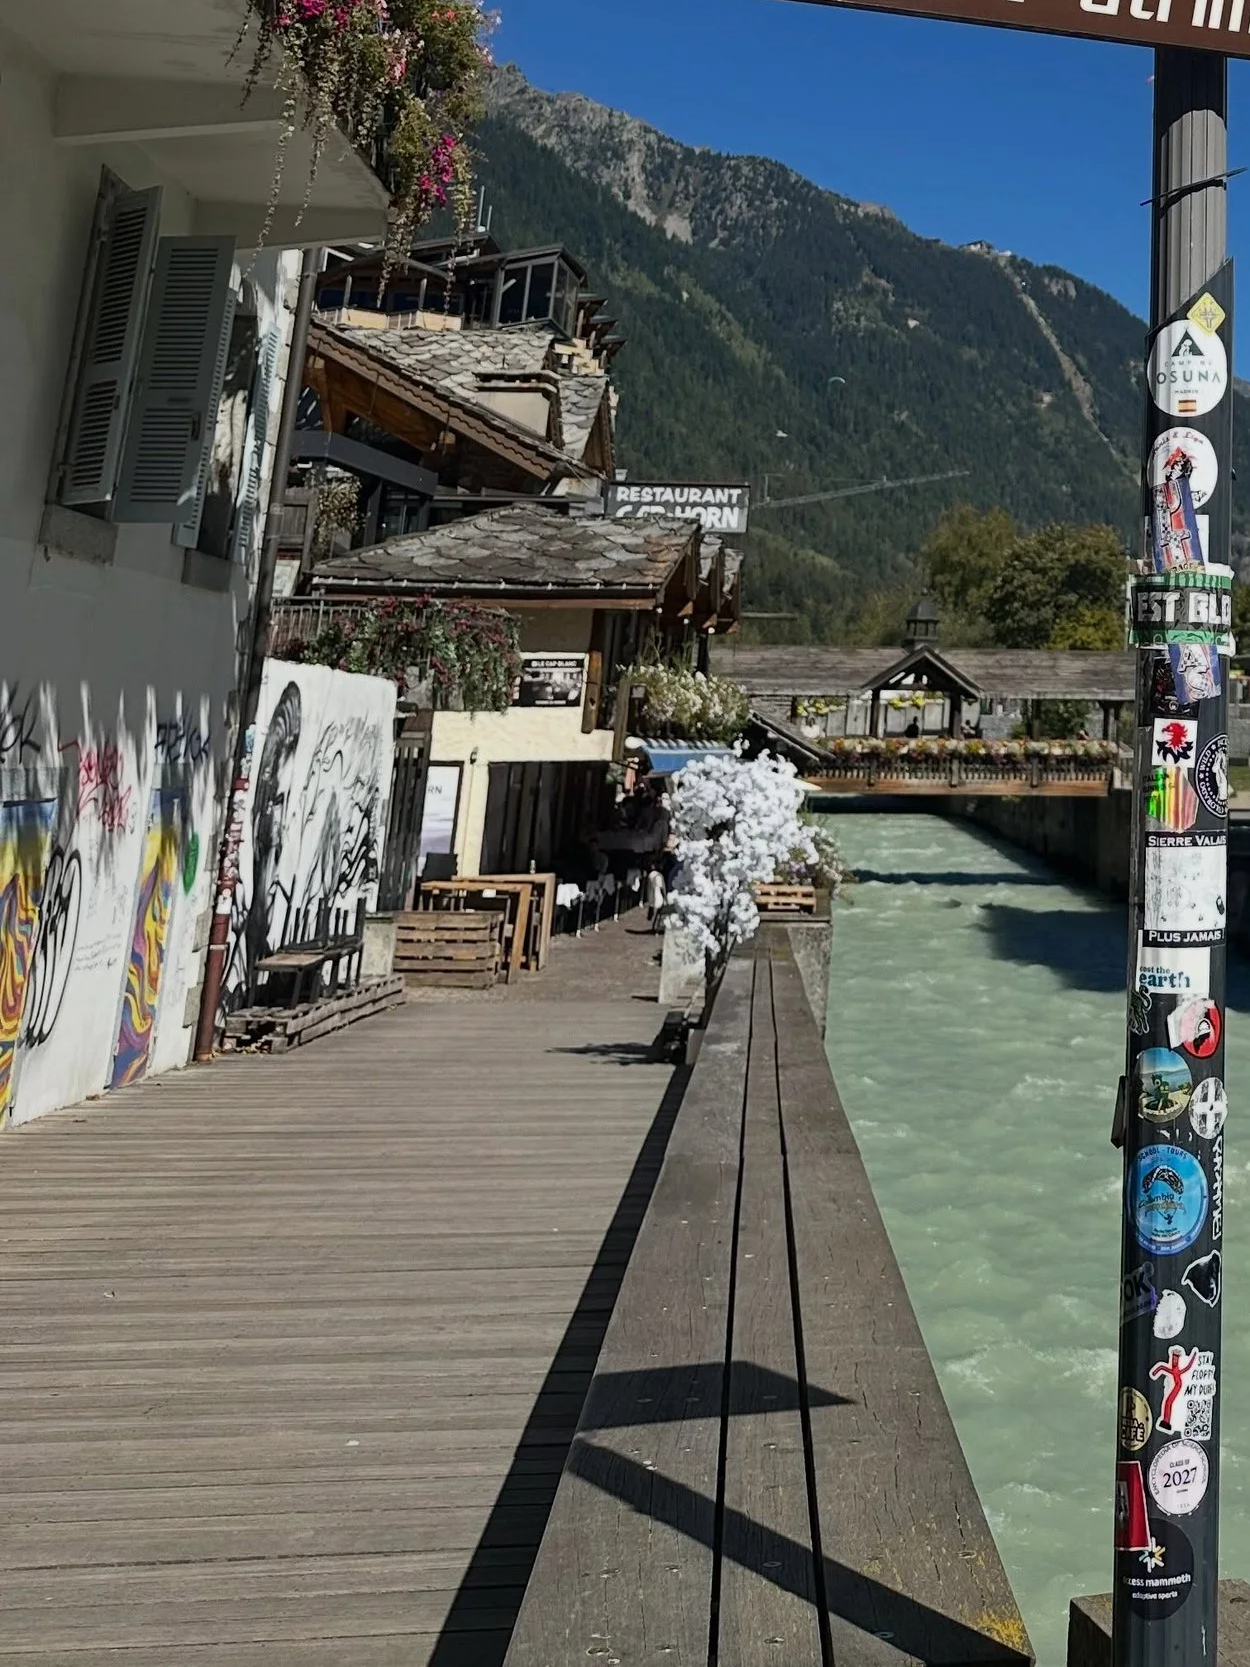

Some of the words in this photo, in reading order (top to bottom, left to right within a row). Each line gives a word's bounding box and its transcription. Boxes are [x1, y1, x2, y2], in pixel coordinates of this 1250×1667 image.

[1164, 360, 1213, 368] CAMPNG
[1156, 370, 1221, 385] OSUNA
[616, 486, 742, 504] RESTAURANT
[1137, 590, 1181, 623] EST
[1199, 749, 1212, 771] WILD
[1148, 835, 1193, 847] SIERRE
[1195, 835, 1227, 845] VALAIS
[1149, 931, 1181, 942] PLUS
[1183, 930, 1222, 942] JAMAIS
[1156, 966, 1171, 974] the
[1139, 971, 1191, 988] earth
[1163, 1466, 1197, 1488] 2027
[1145, 1573, 1191, 1588] mammoth
